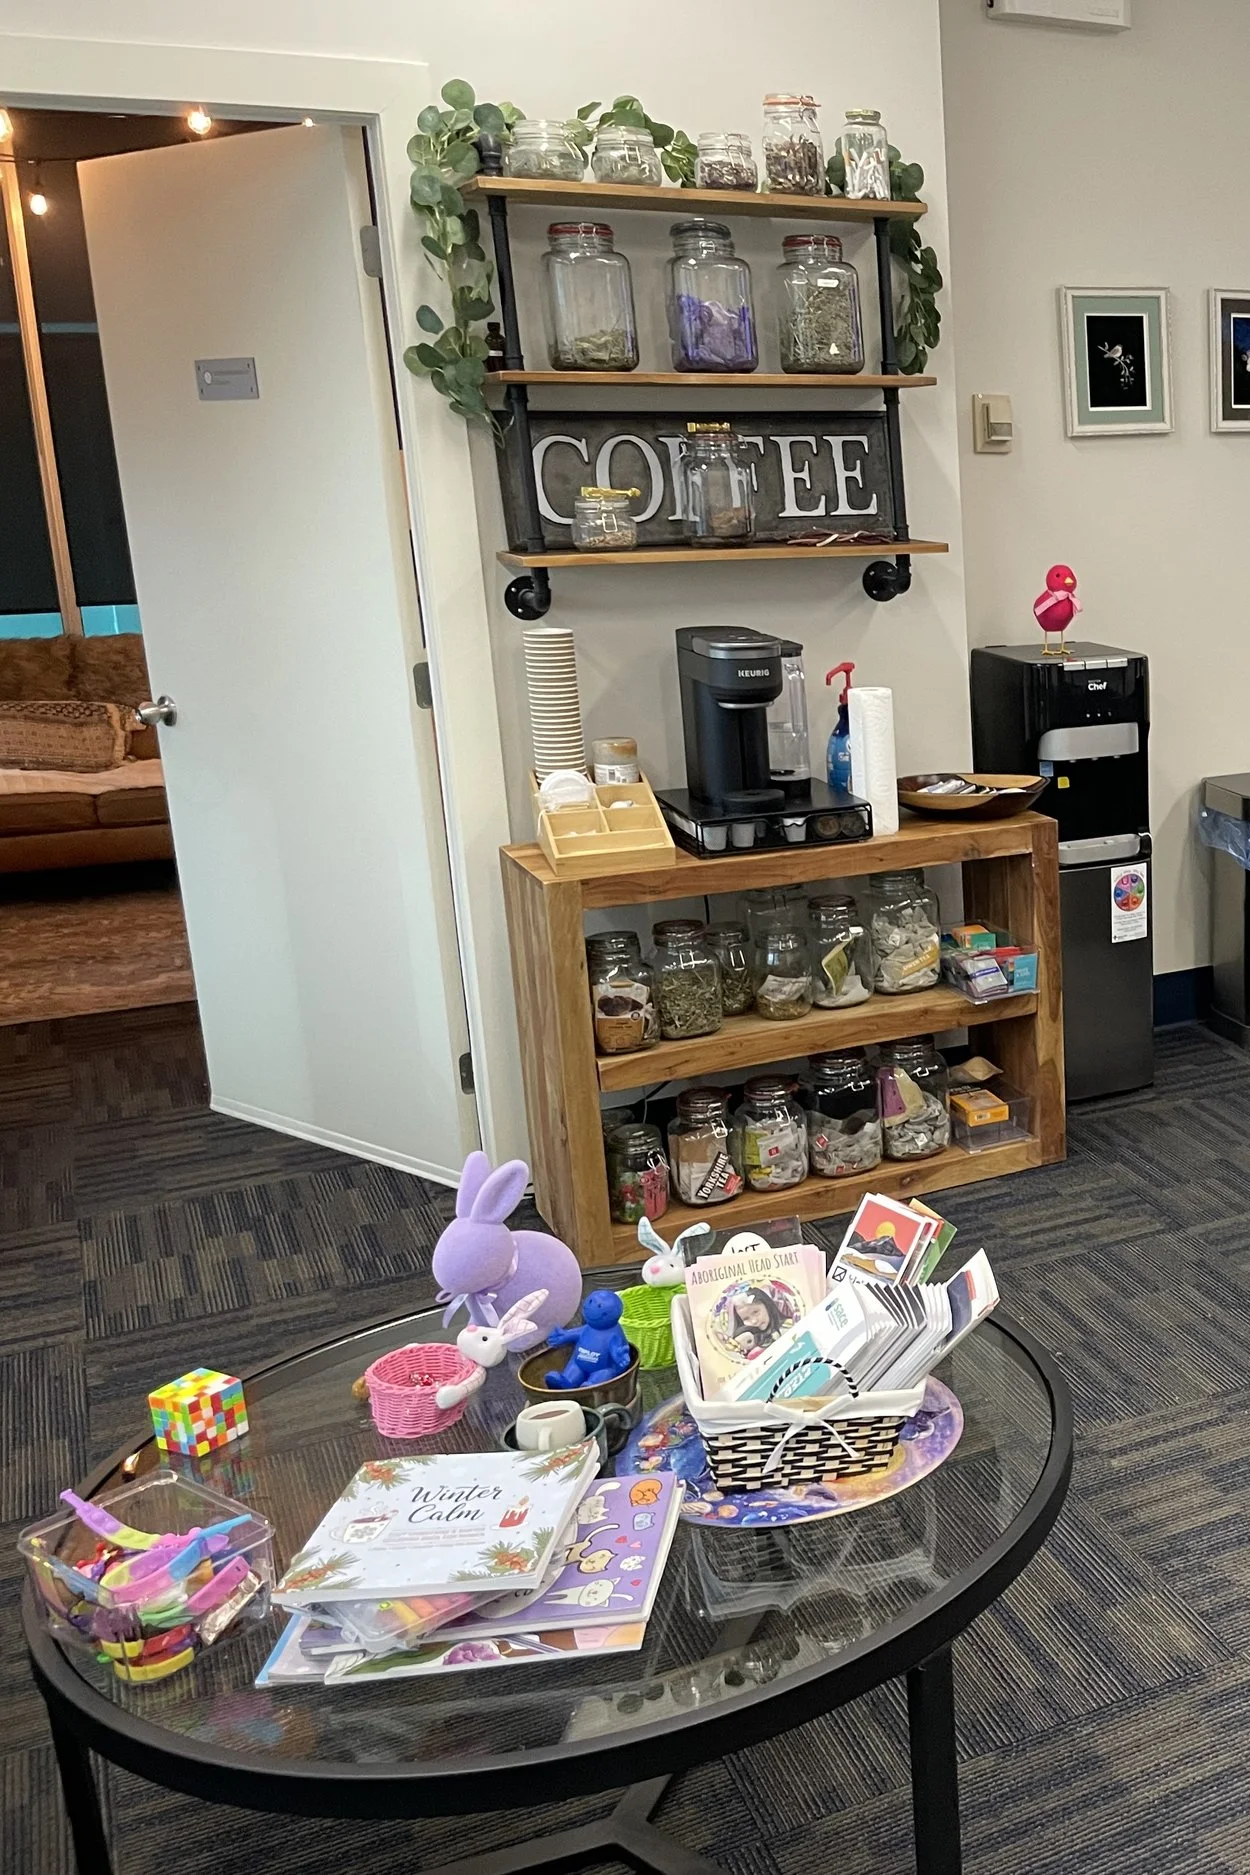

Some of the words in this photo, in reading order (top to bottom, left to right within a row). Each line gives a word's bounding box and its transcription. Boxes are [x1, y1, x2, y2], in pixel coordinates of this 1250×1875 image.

[532, 433, 879, 525] COFFEE
[737, 669, 770, 678] KEURIG
[697, 1153, 729, 1198] YORKSHIRE
[716, 1172, 730, 1188] TEA
[691, 1262, 747, 1286] ABORIGINAL
[748, 1257, 772, 1274] HEAD
[773, 1251, 800, 1269] START
[411, 1484, 503, 1502] Winter
[408, 1503, 485, 1524] Calm
